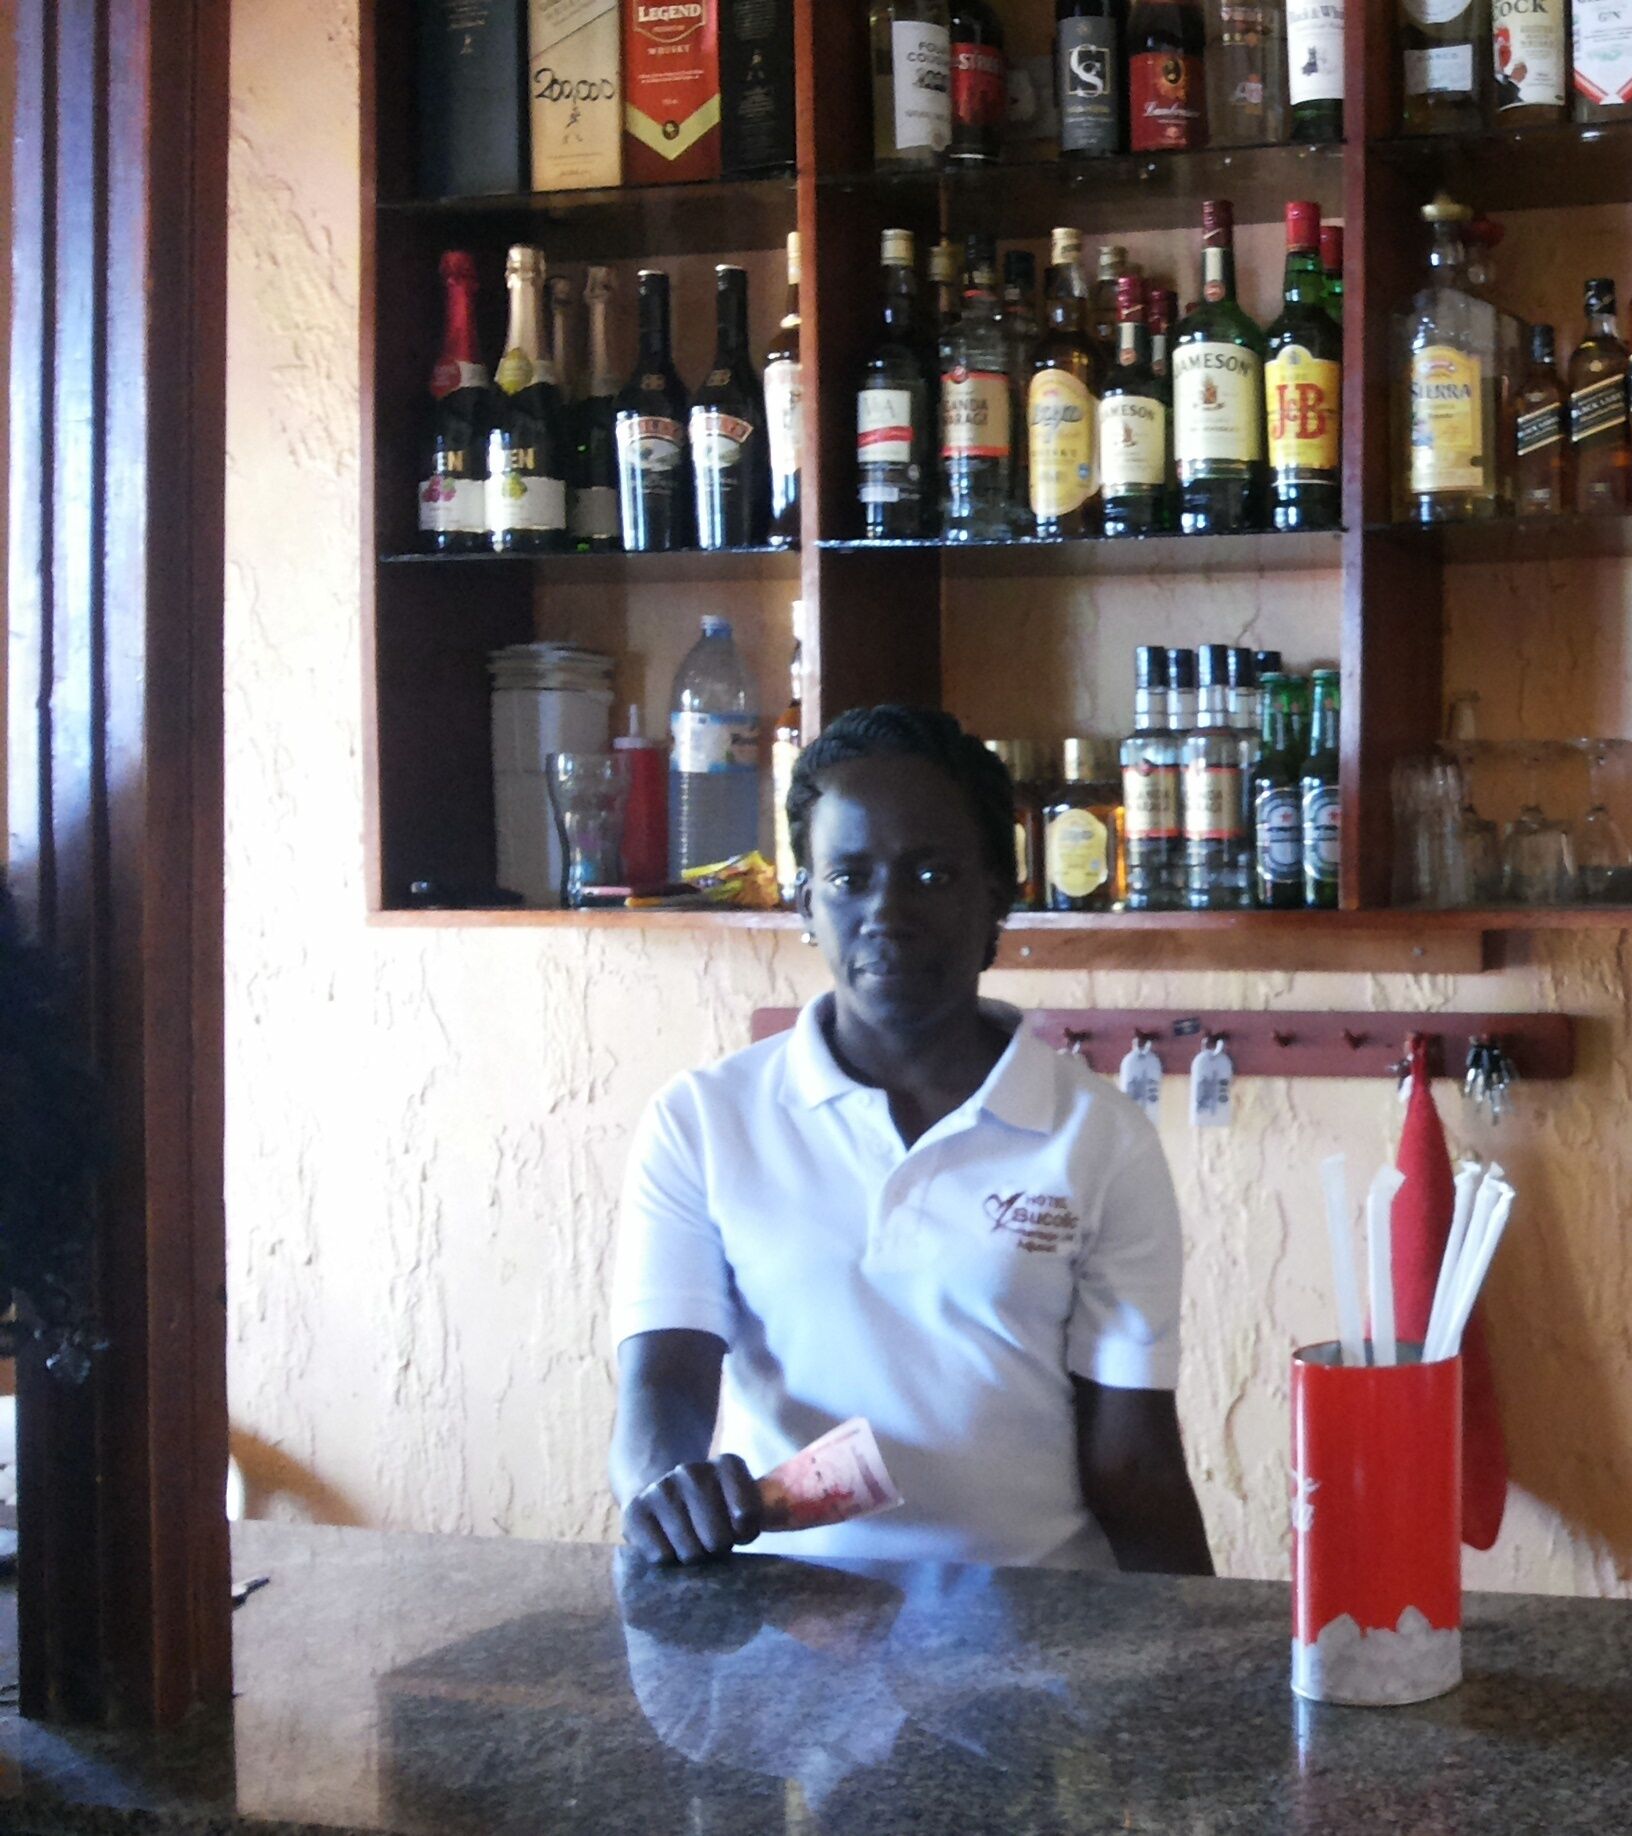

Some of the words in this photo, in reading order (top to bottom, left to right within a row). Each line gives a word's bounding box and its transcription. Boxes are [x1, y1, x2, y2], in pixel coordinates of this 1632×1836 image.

[638, 3, 702, 22] LEGEND
[1174, 352, 1250, 379] JAMESON
[1101, 402, 1154, 421] AMESON
